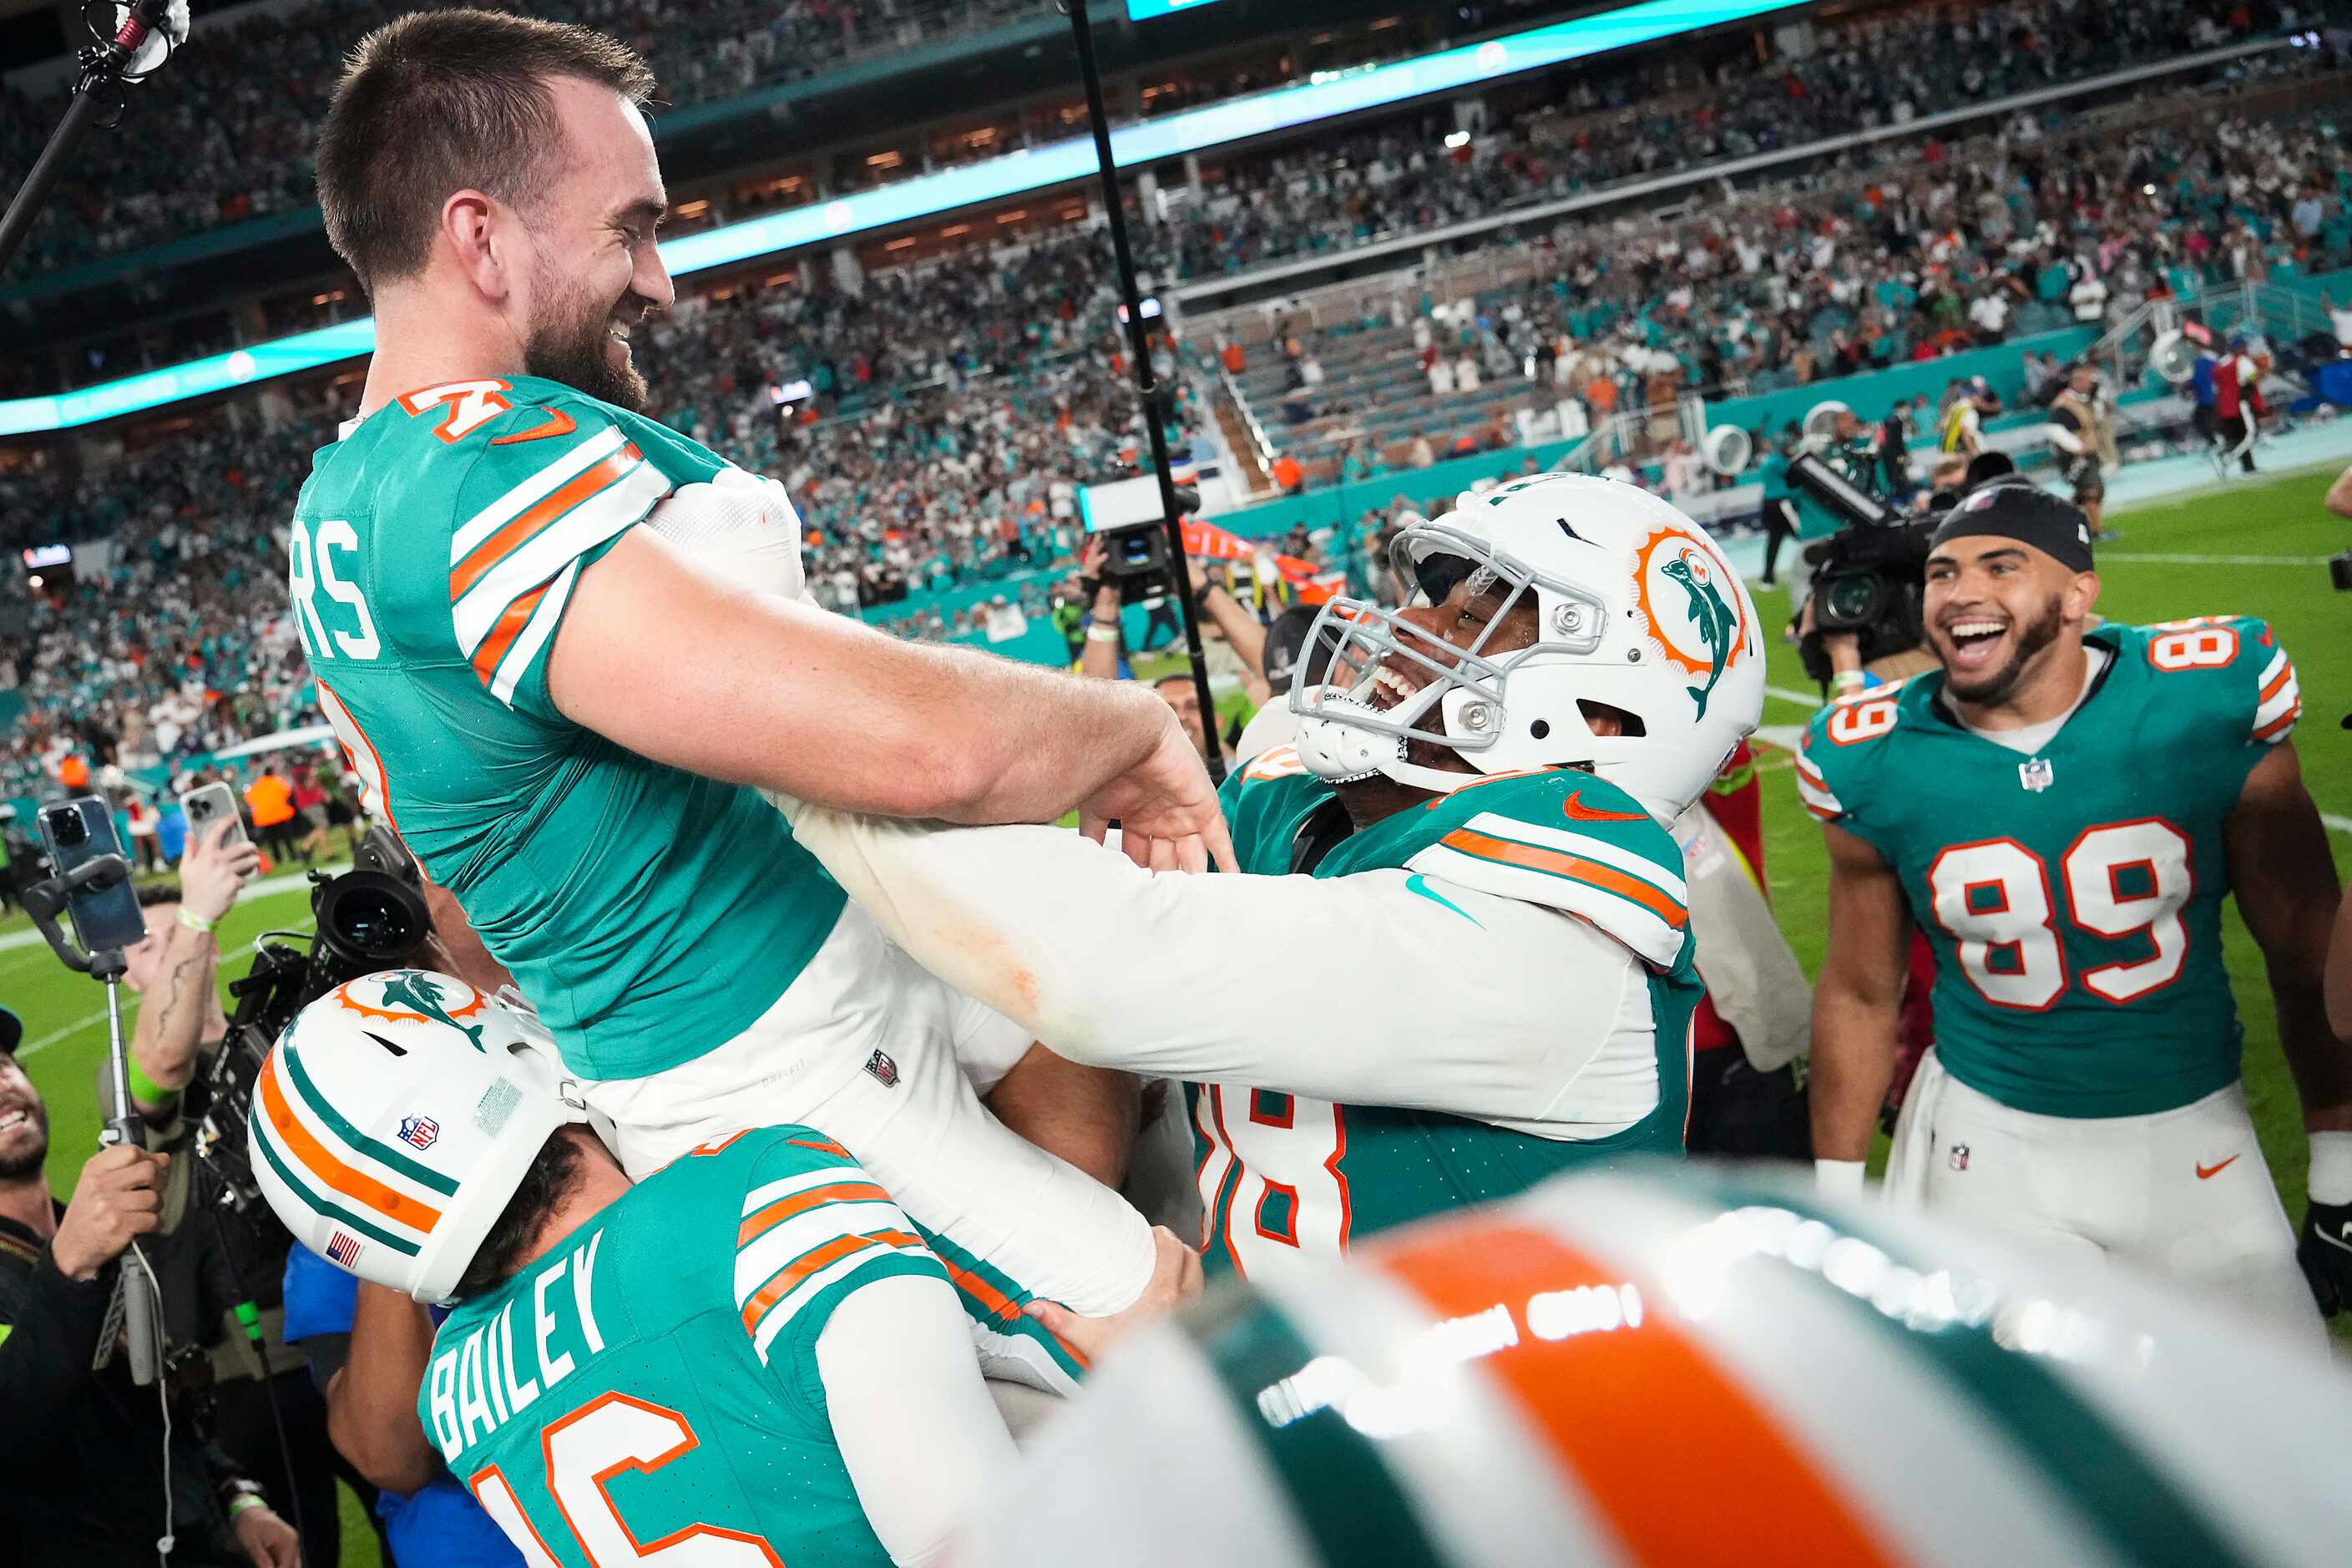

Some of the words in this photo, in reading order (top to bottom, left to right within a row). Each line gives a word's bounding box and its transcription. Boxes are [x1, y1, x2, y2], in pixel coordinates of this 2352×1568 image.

[1926, 815, 2196, 1013] 89
[410, 1121, 437, 1148] NFL
[1196, 1082, 1352, 1283] 8
[430, 1227, 604, 1464] BAILEY
